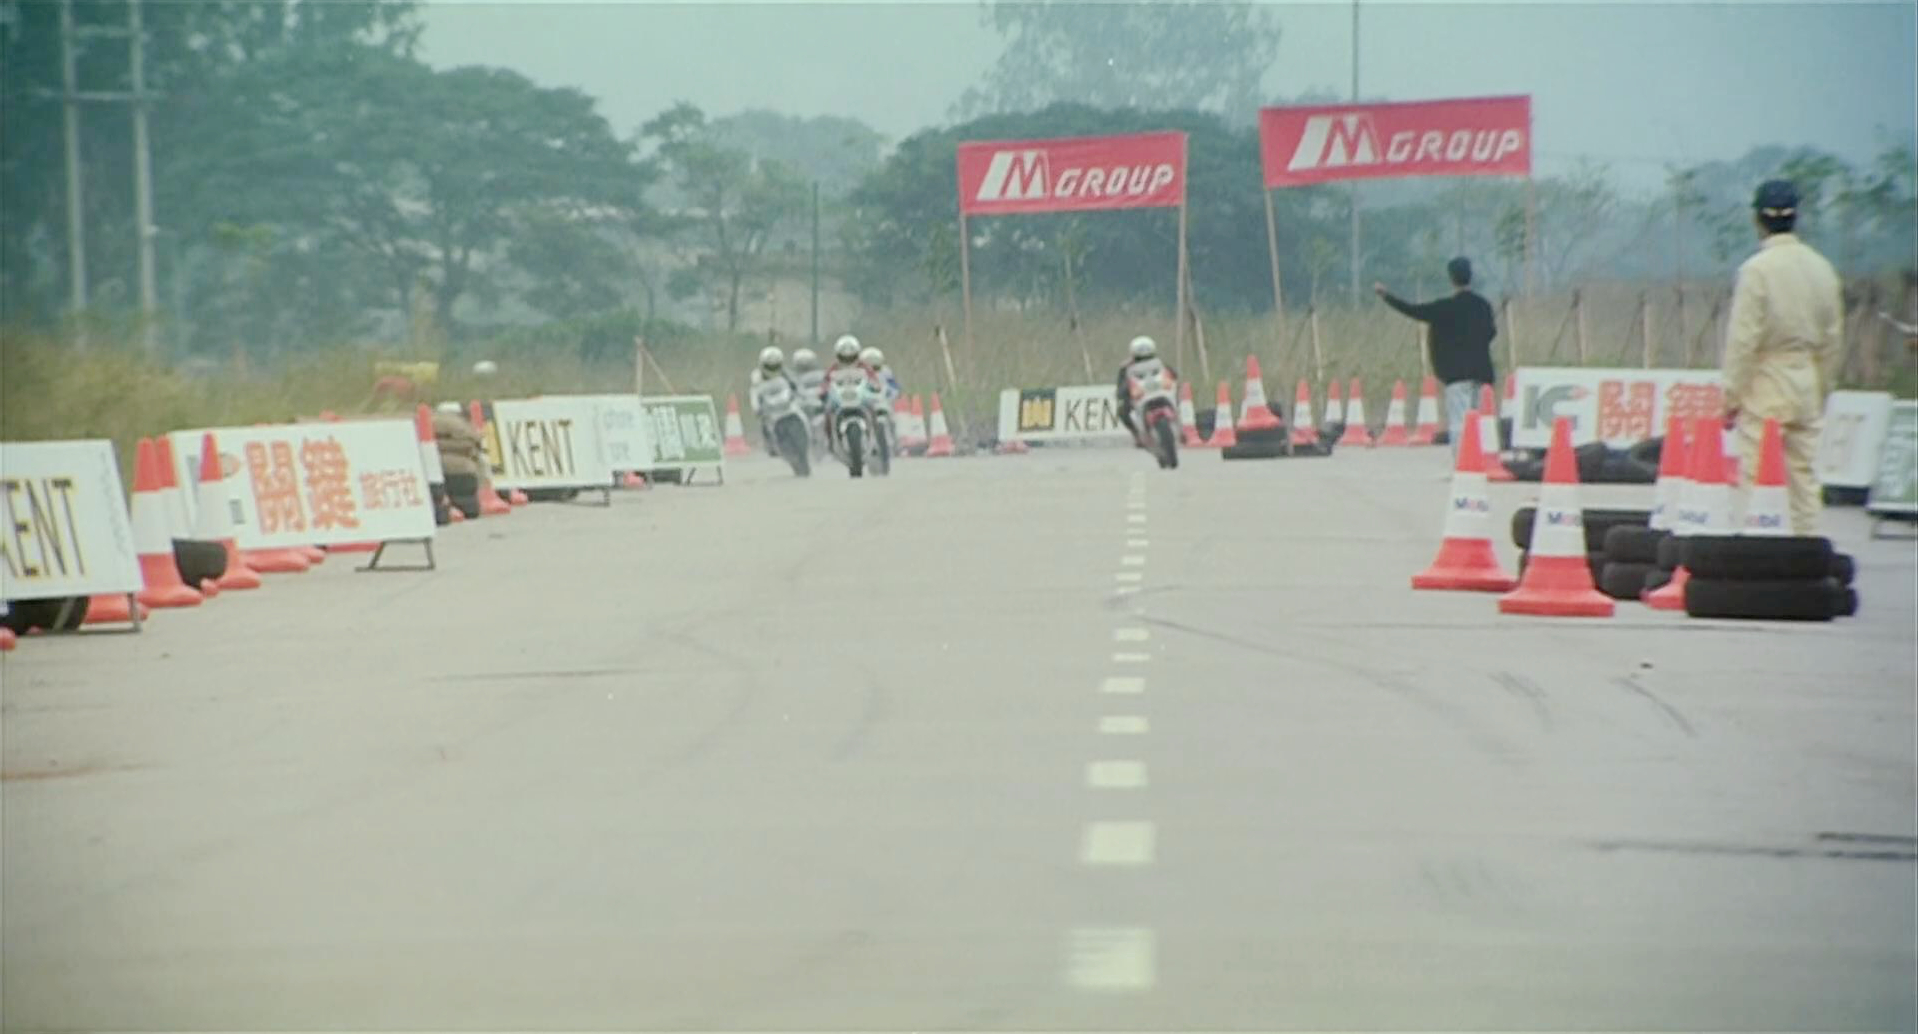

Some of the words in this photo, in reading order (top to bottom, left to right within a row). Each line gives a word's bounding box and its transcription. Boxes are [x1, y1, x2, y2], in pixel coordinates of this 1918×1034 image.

[1386, 128, 1521, 163] GROUP
[1054, 163, 1175, 198] GROUP
[1064, 398, 1121, 432] KEN
[506, 419, 576, 477] KENT
